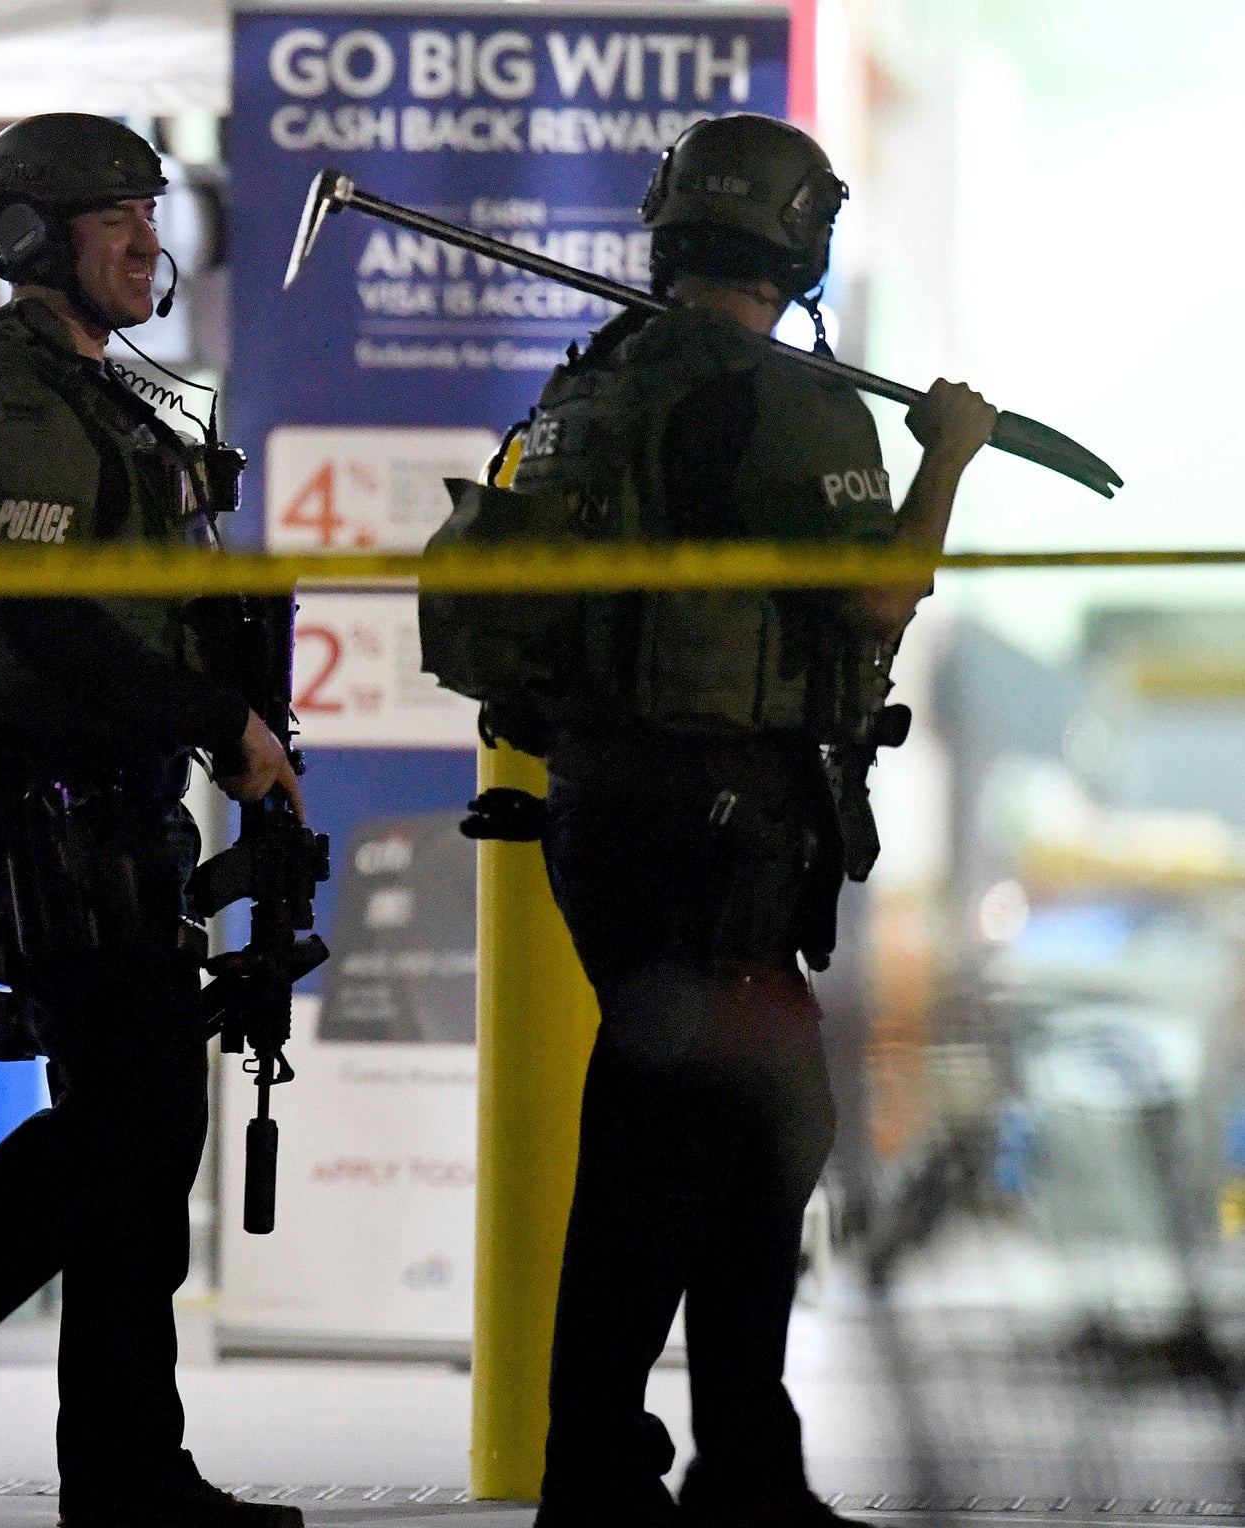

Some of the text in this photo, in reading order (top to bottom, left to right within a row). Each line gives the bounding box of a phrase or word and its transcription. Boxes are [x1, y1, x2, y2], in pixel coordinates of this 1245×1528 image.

[269, 28, 751, 103] GO BIG WITH
[269, 104, 716, 153] CASH BACK REWAR
[822, 468, 891, 507] POLI
